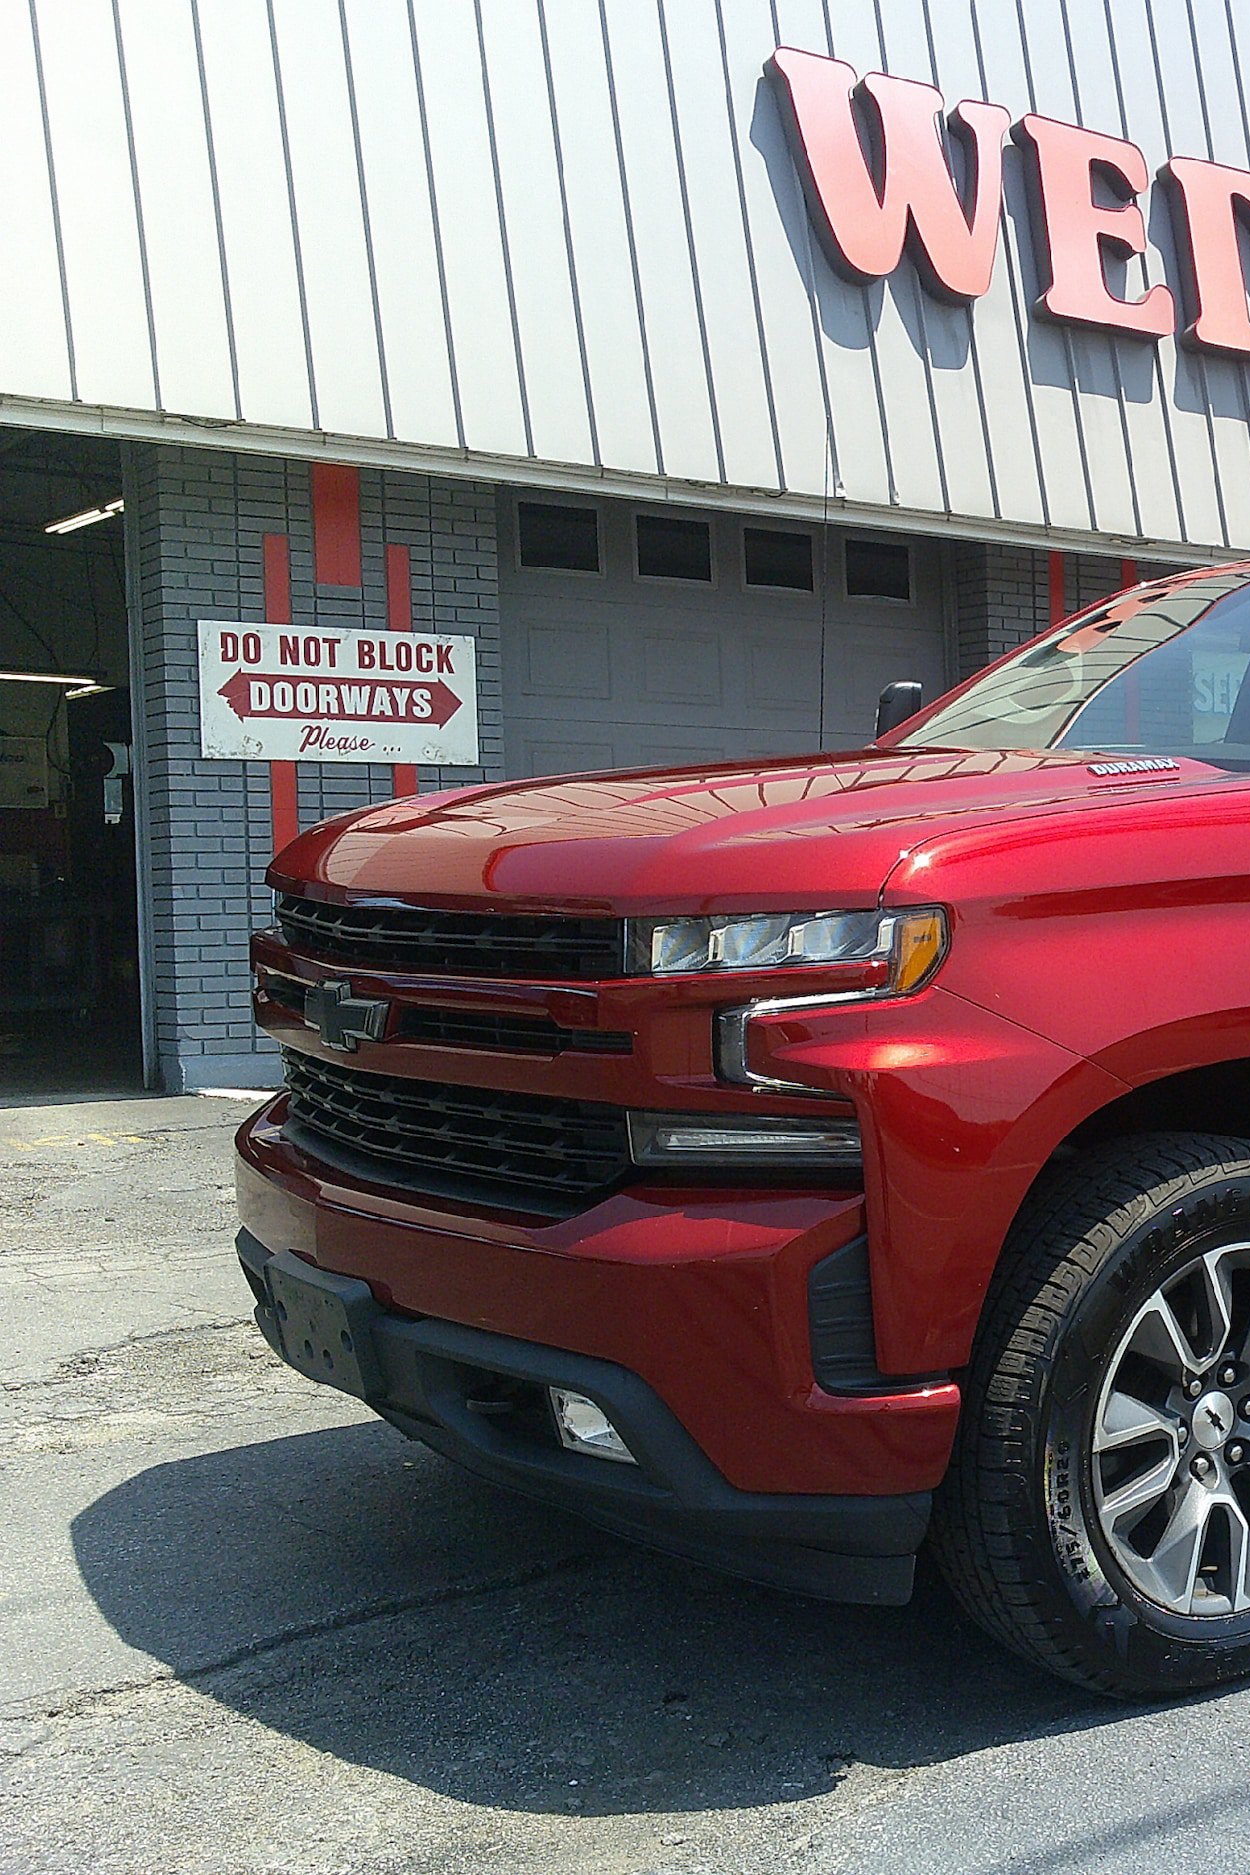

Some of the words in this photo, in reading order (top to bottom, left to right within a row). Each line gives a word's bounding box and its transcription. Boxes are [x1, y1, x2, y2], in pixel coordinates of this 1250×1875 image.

[220, 632, 262, 664] DO
[279, 635, 341, 668] NOT
[357, 640, 455, 674] BLOCK
[250, 680, 433, 718] DOORWAYS
[299, 725, 376, 752] Please
[1087, 758, 1180, 777] DURAMAX
